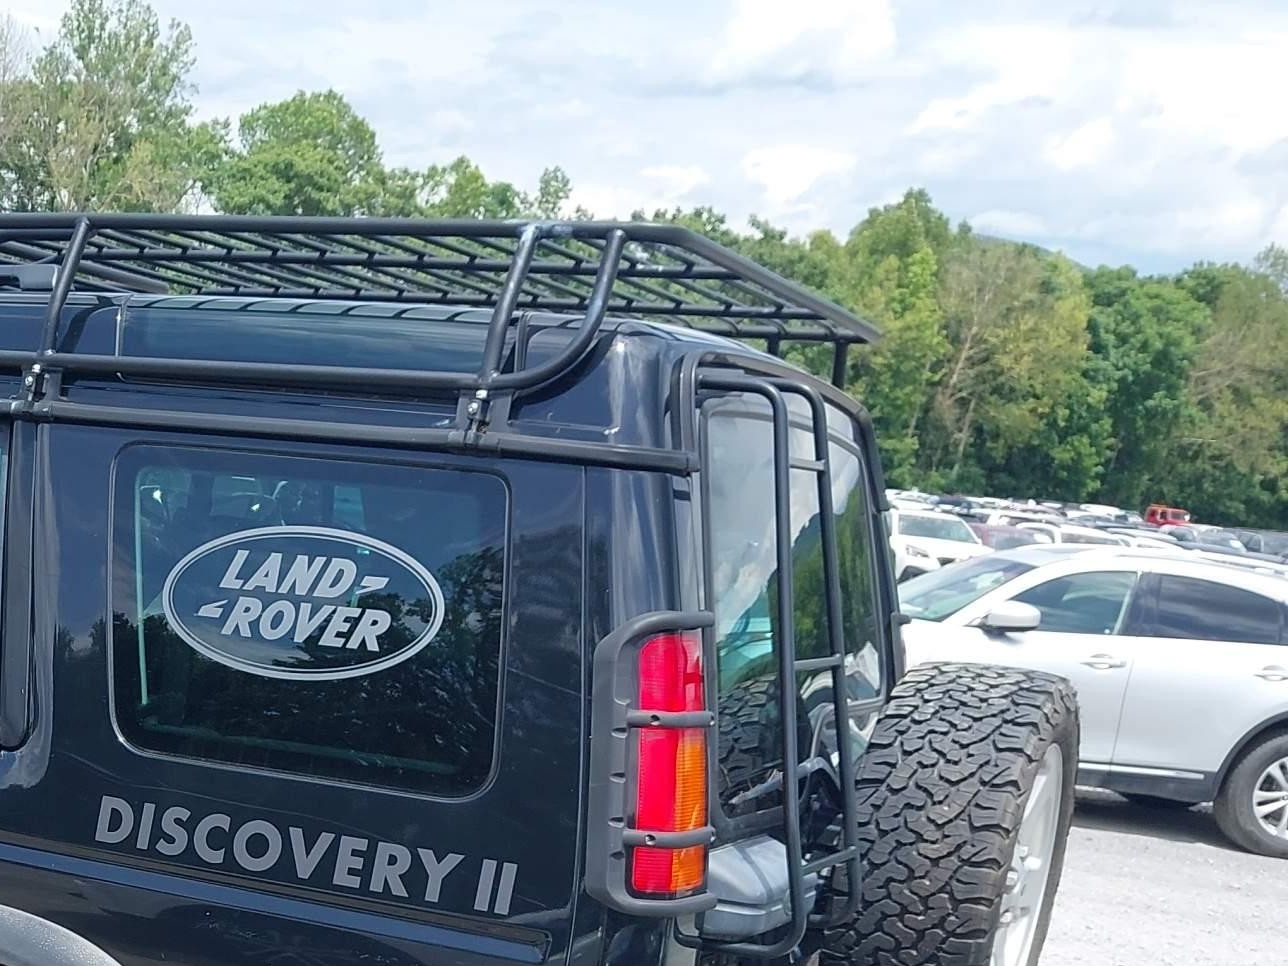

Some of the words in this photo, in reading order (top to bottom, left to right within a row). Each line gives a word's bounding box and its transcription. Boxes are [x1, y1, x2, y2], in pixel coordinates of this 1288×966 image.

[219, 549, 357, 598] LAND
[220, 596, 392, 652] ROVER
[94, 795, 466, 903] DISCOVERY
[473, 858, 519, 916] II
